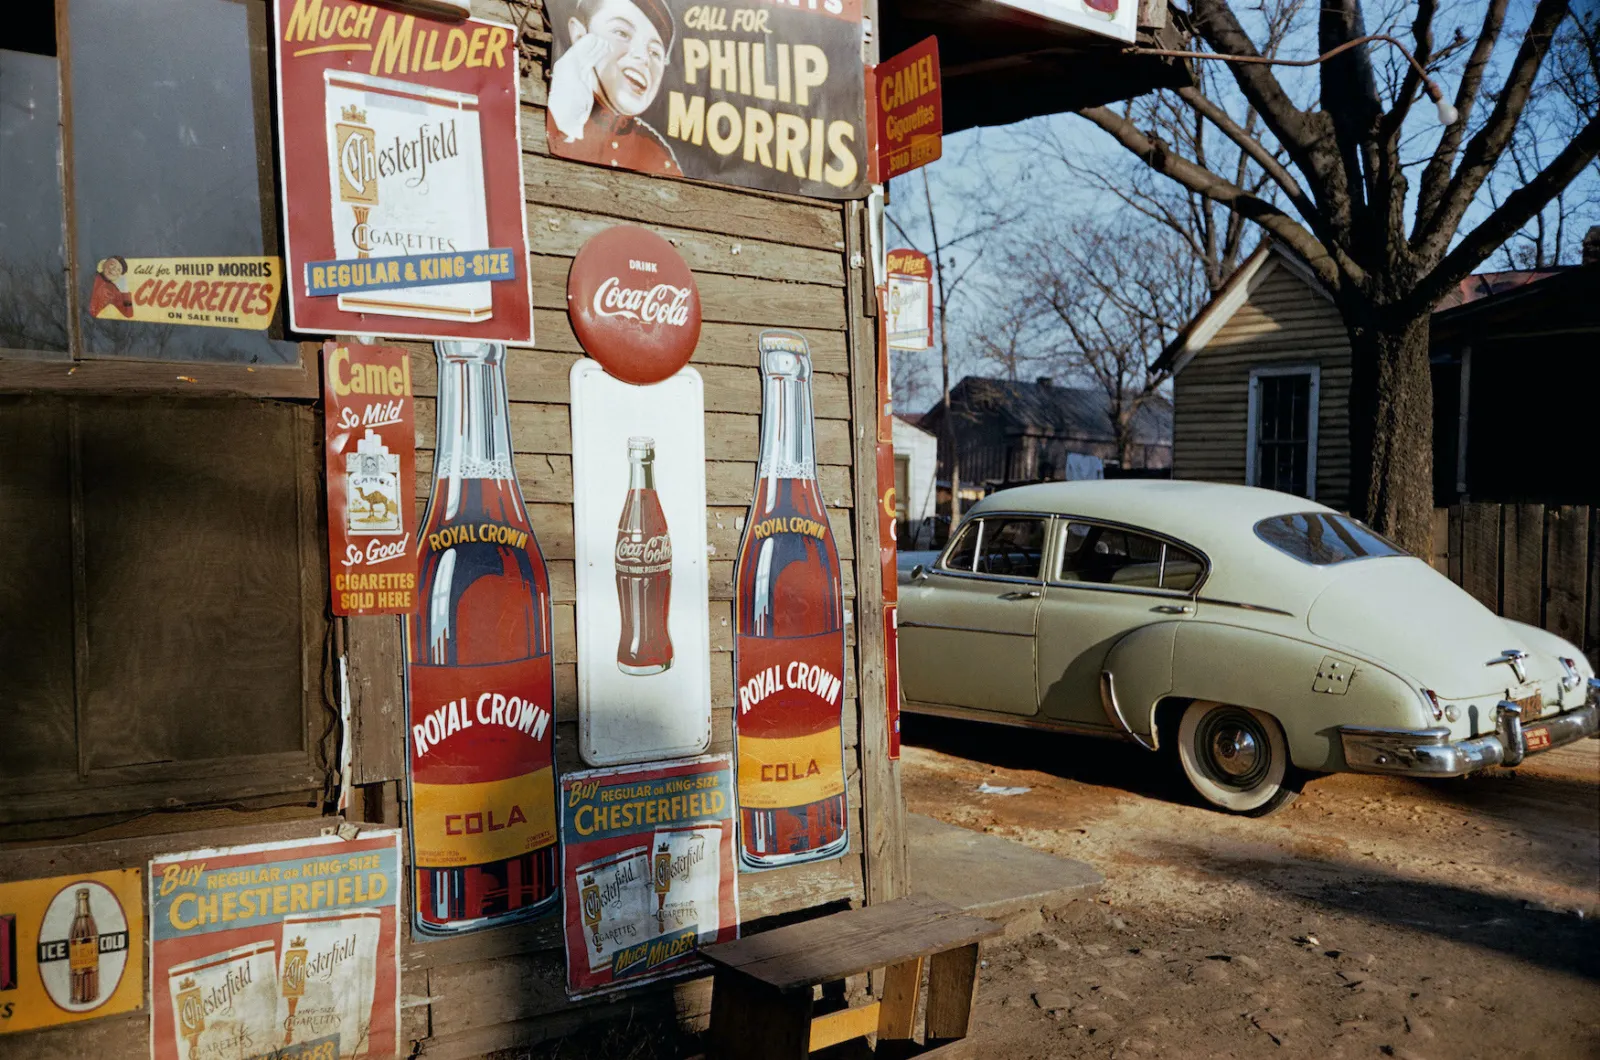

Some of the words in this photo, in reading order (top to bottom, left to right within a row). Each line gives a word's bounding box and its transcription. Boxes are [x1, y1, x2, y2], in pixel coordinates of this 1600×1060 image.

[284, 0, 378, 42] MUCH
[369, 14, 508, 76] MILDER
[684, 6, 727, 32] CALL
[731, 9, 773, 34] FOR
[683, 38, 829, 107] PHILIP
[880, 54, 937, 113] CAMEL
[667, 91, 859, 189] MORRIS
[886, 104, 935, 142] Cigarettes
[341, 119, 460, 195] Chesterfield
[352, 222, 457, 256] CIGARETTES
[133, 264, 152, 276] Call
[156, 265, 170, 277] for
[175, 263, 214, 277] PHILIP
[218, 262, 272, 277] MORRIS
[312, 260, 400, 289] REGULAR
[404, 260, 417, 281] &
[419, 253, 509, 279] KING-SIZE
[629, 259, 658, 273] DRINK
[134, 278, 274, 316] CIGARETTES
[593, 277, 692, 327] Coca-Cola
[168, 311, 183, 320] ON
[187, 313, 210, 322] SALE
[215, 315, 239, 324] HERE
[328, 347, 412, 397] Camel
[337, 406, 360, 430] So
[362, 399, 404, 426] Mild
[428, 524, 477, 552] ROYAL
[479, 523, 529, 550] CROWN
[754, 517, 788, 540] ROYAL
[789, 516, 826, 540] CROWN
[341, 545, 363, 567] So
[366, 533, 410, 561] Good
[335, 573, 415, 591] CIGARETTES
[340, 592, 374, 610] SOLD
[377, 591, 411, 609] HERE
[739, 665, 784, 716] ROYAL
[786, 661, 842, 706] CROWN
[412, 697, 473, 759] ROYAL
[475, 692, 551, 742] CROWN
[601, 785, 651, 803] REGULAR
[665, 775, 719, 794] KING-SIZE
[761, 759, 821, 783] COLA
[445, 805, 528, 836] COLA
[574, 790, 725, 836] CHESTERFIELD
[207, 867, 280, 890] REGULAR
[283, 868, 299, 880] OR
[301, 854, 381, 877] KING-SIZE
[169, 873, 388, 931] CHESTERFIELD
[41, 943, 66, 960] ICE
[100, 934, 125, 951] COLD
[592, 923, 637, 947] CIGARETTES
[615, 943, 649, 972] MUCH
[646, 931, 696, 968] MILDER
[285, 933, 357, 990] Chesterfield
[182, 961, 252, 1029] Chesterfield
